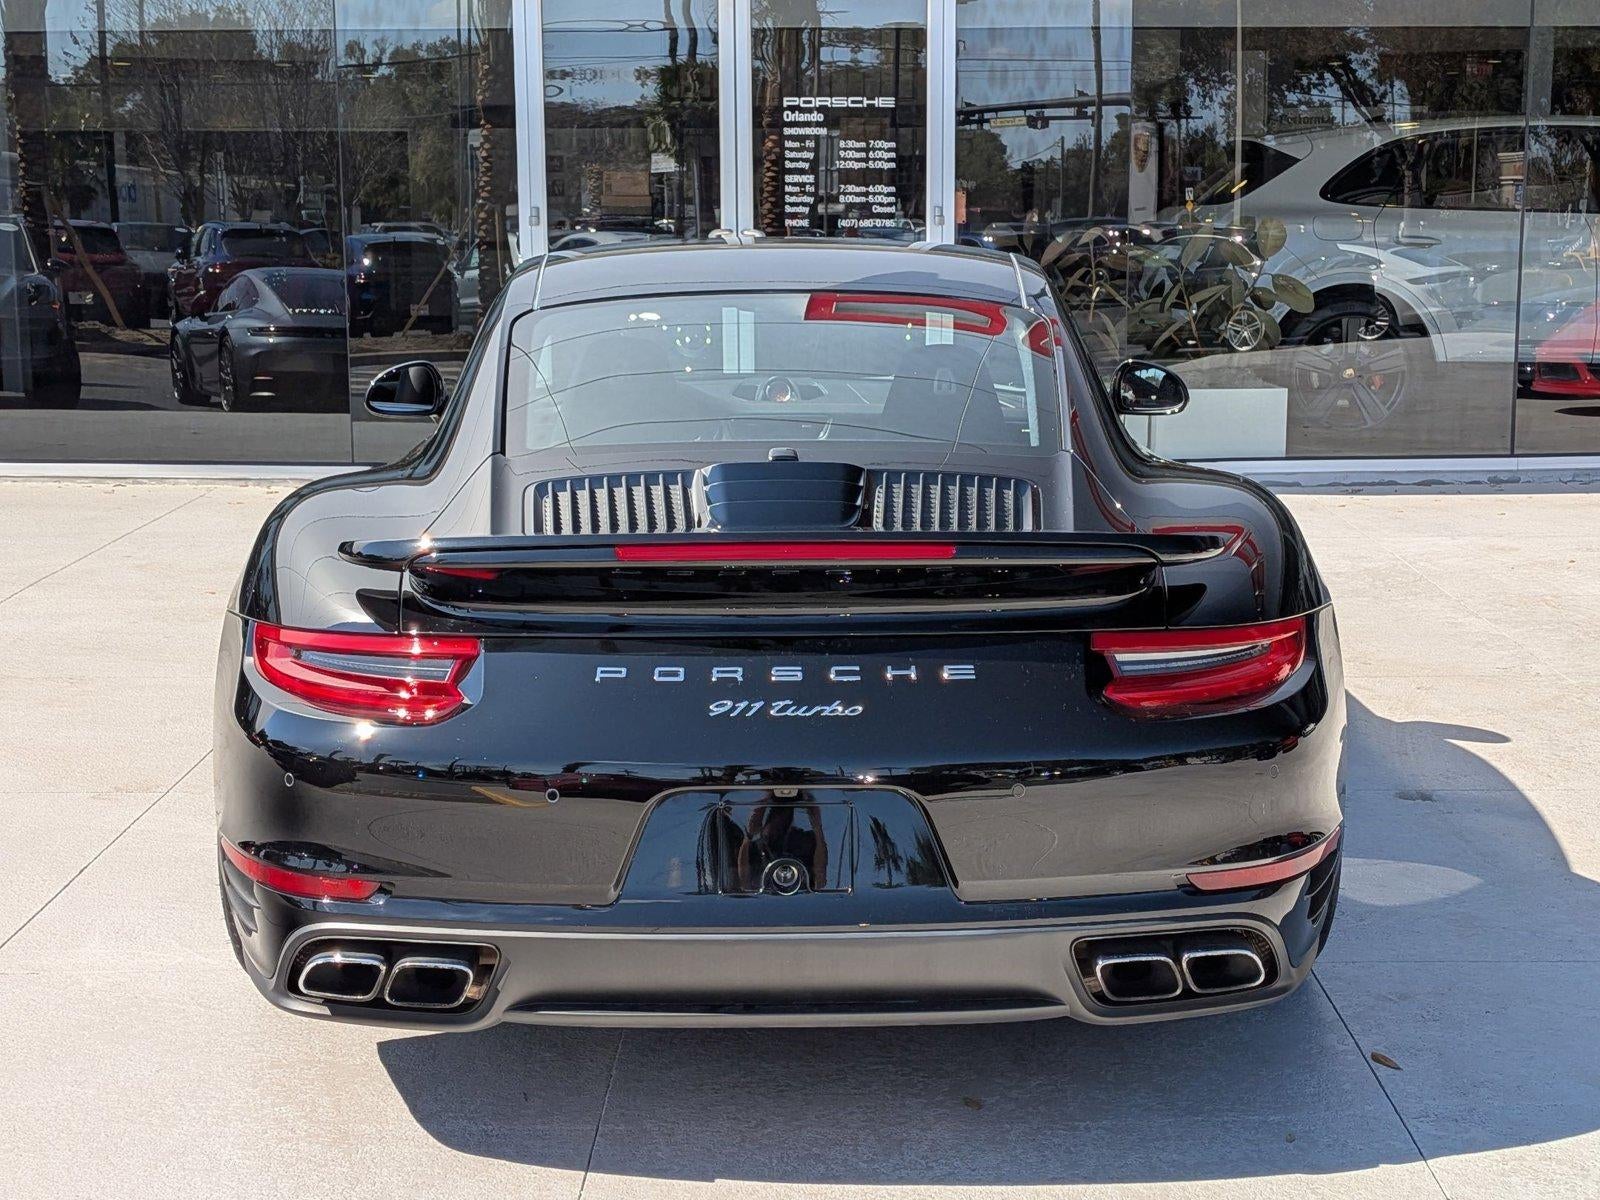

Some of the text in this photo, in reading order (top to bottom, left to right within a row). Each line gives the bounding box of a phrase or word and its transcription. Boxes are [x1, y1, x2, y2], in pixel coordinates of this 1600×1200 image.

[783, 97, 895, 108] PORSCHE
[783, 110, 824, 121] Orlando
[783, 127, 827, 135] SHOWROOM
[784, 140, 800, 148] Mon
[805, 140, 815, 148] Fri
[784, 150, 814, 159] Saturday
[784, 160, 810, 169] Sunday
[784, 175, 815, 183] SERVICE
[784, 195, 814, 204] Saturday
[784, 205, 895, 214] Sunday Closed
[784, 219, 810, 227] PHONE
[837, 219, 858, 228] (407)
[595, 665, 977, 682] PORSCHE
[708, 700, 765, 717] 911
